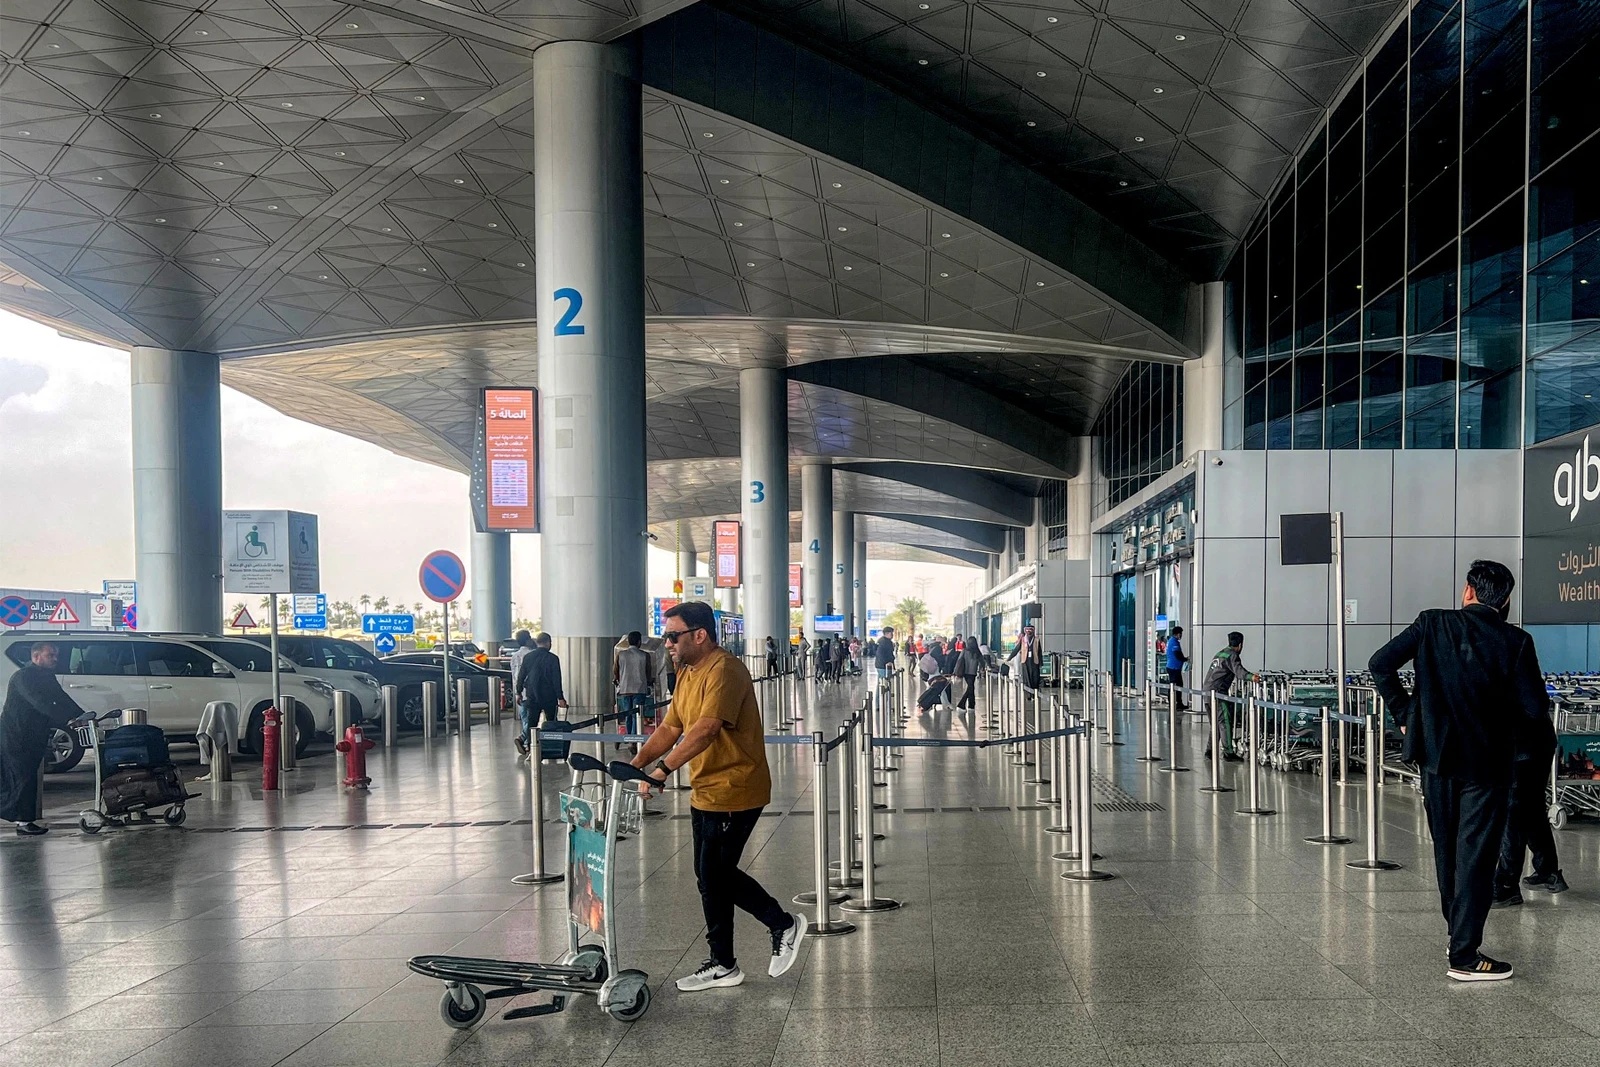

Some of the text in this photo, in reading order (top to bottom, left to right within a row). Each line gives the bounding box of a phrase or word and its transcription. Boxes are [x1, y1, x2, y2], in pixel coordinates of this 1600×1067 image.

[553, 287, 585, 336] 2
[490, 407, 527, 419] الصالة 5
[749, 481, 765, 504] 3
[808, 539, 821, 554] 4
[836, 563, 844, 575] 5
[853, 579, 860, 589] 6
[1558, 580, 1600, 602] Wealth
